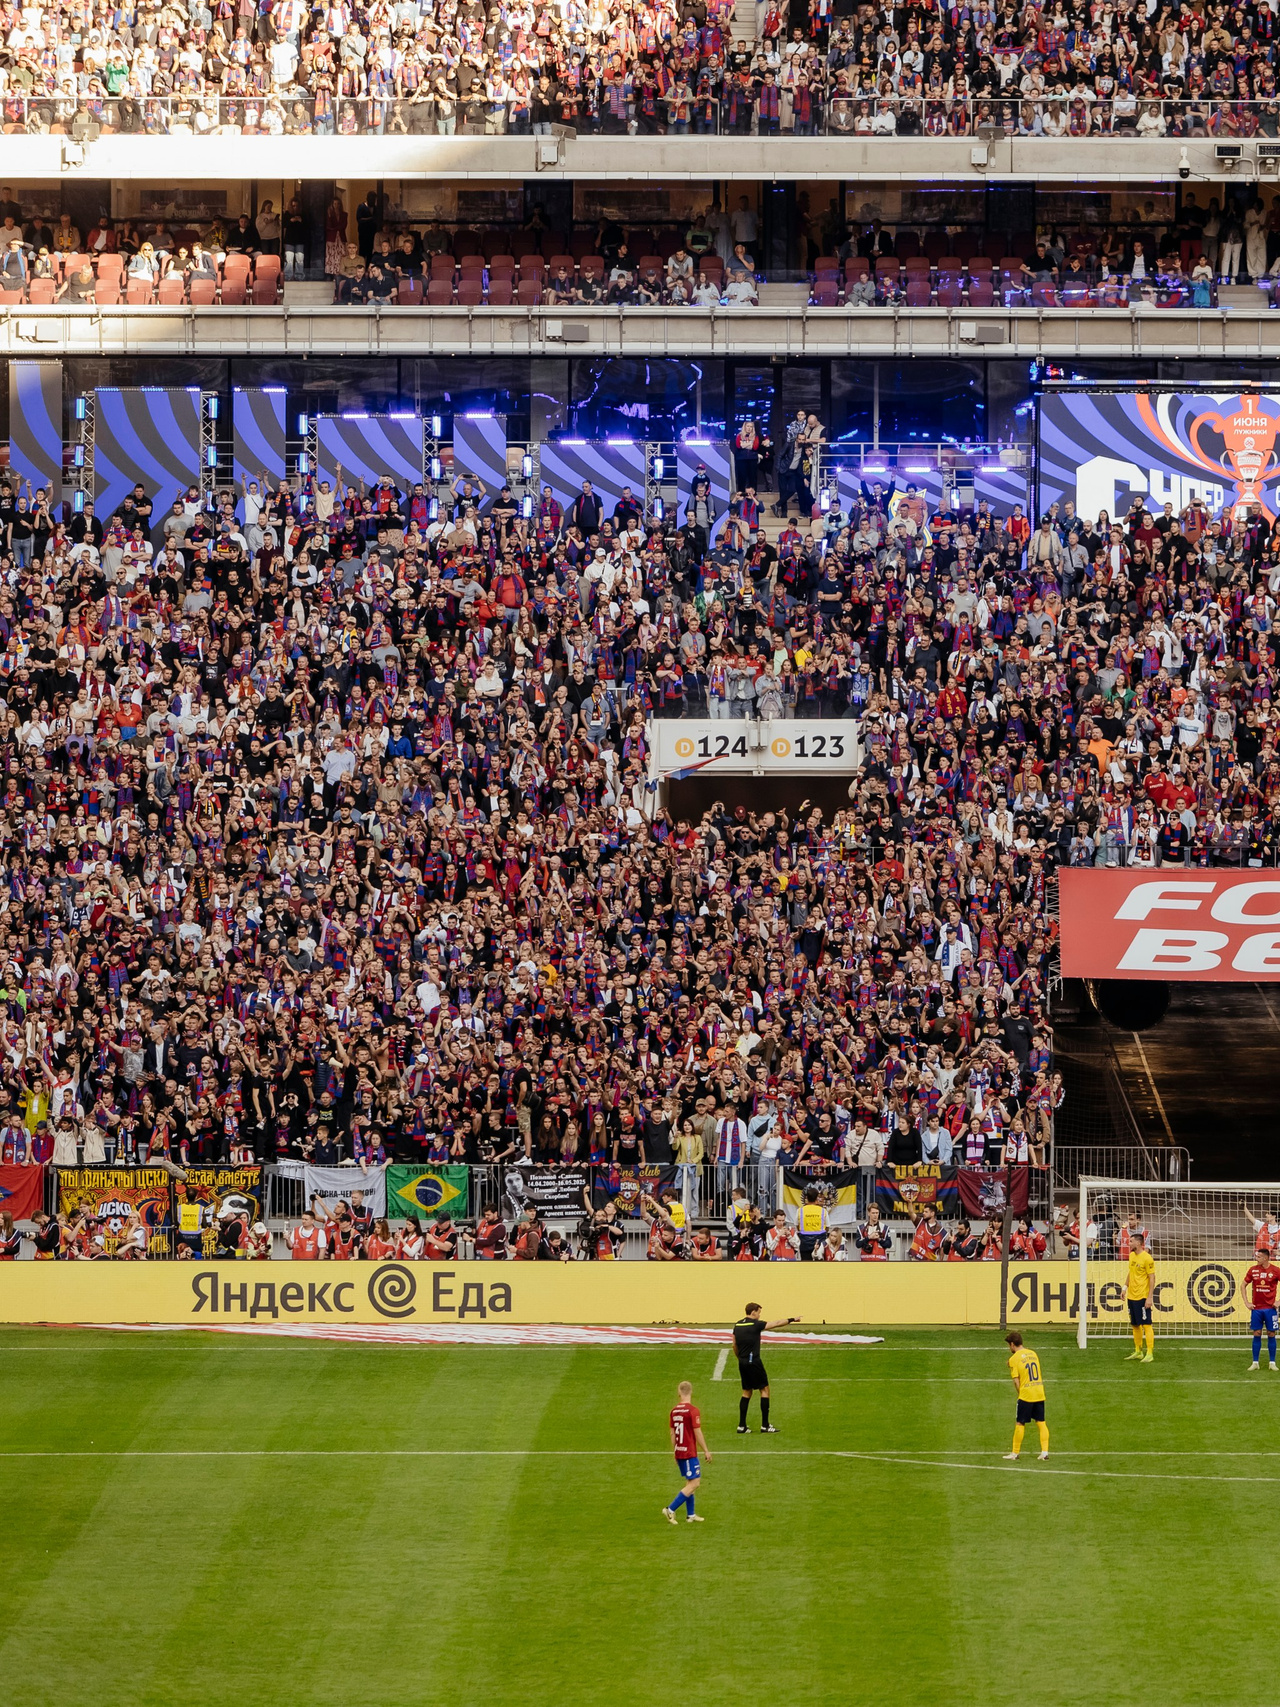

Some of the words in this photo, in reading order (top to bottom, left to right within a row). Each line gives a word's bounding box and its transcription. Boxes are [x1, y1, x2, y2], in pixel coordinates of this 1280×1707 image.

[1246, 399, 1253, 415] 1
[1233, 417, 1268, 427] ИЮНЯ
[1076, 455, 1225, 531] СУПЕР
[697, 735, 748, 758] 124
[794, 735, 845, 758] 123
[81, 1168, 134, 1189] ФАНАТЫ
[136, 1169, 169, 1189] ЦСКА
[178, 1169, 215, 1185] СЕГДА
[218, 1170, 260, 1187] ВМЕСТЕ
[405, 1167, 450, 1175] TORCIDA
[639, 1164, 660, 1177] club
[98, 1201, 132, 1218] ЦСКА
[191, 1271, 355, 1319] Яндекс
[432, 1271, 513, 1319] Еда
[1011, 1272, 1174, 1319] Яндес
[1025, 1362, 1039, 1382] 10
